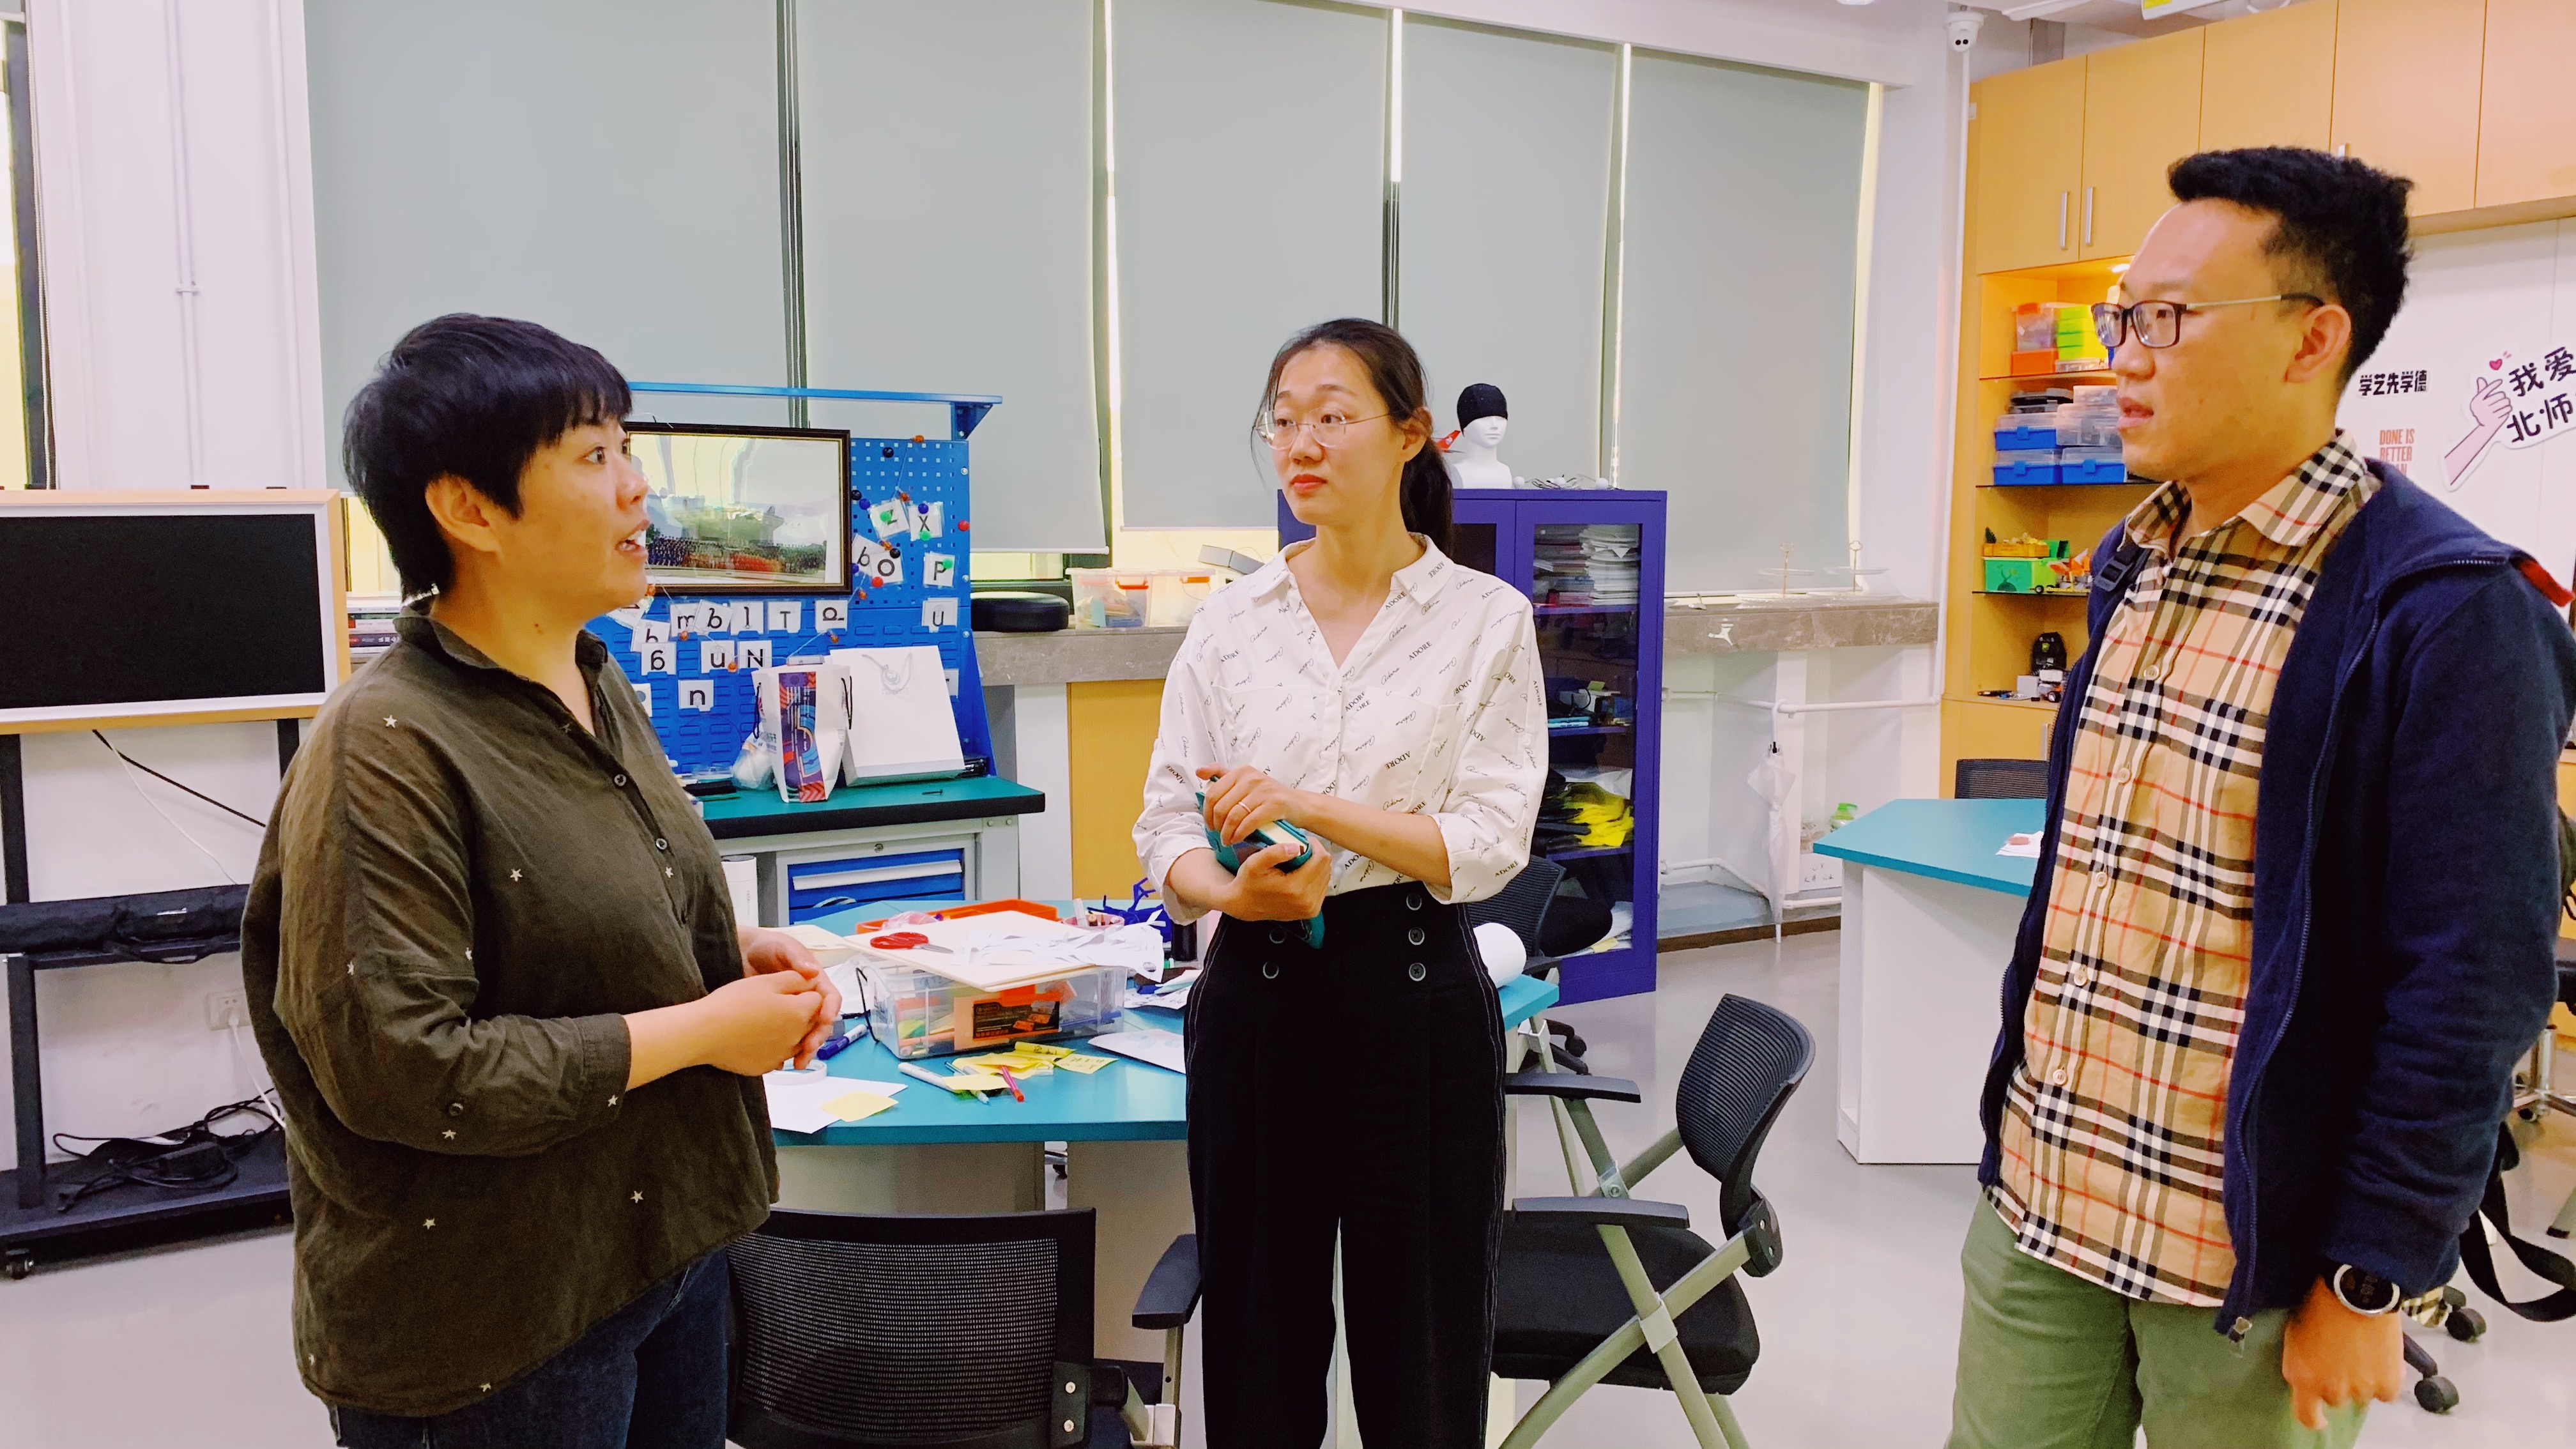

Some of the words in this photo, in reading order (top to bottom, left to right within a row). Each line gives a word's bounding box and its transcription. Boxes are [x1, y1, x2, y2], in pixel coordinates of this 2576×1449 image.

[2509, 347, 2576, 396] 我爱
[2380, 429, 2404, 445] DONE
[2405, 428, 2414, 444] IS
[2380, 446, 2412, 462] BETTER
[1385, 591, 1407, 610] ADORE
[1481, 585, 1505, 601] ADORE
[747, 648, 763, 668] N
[1220, 649, 1240, 664] ADORE
[1408, 641, 1432, 661] ADORE
[690, 690, 705, 705] n
[1384, 751, 1411, 770] ADORE
[1495, 860, 1519, 877] ADORE
